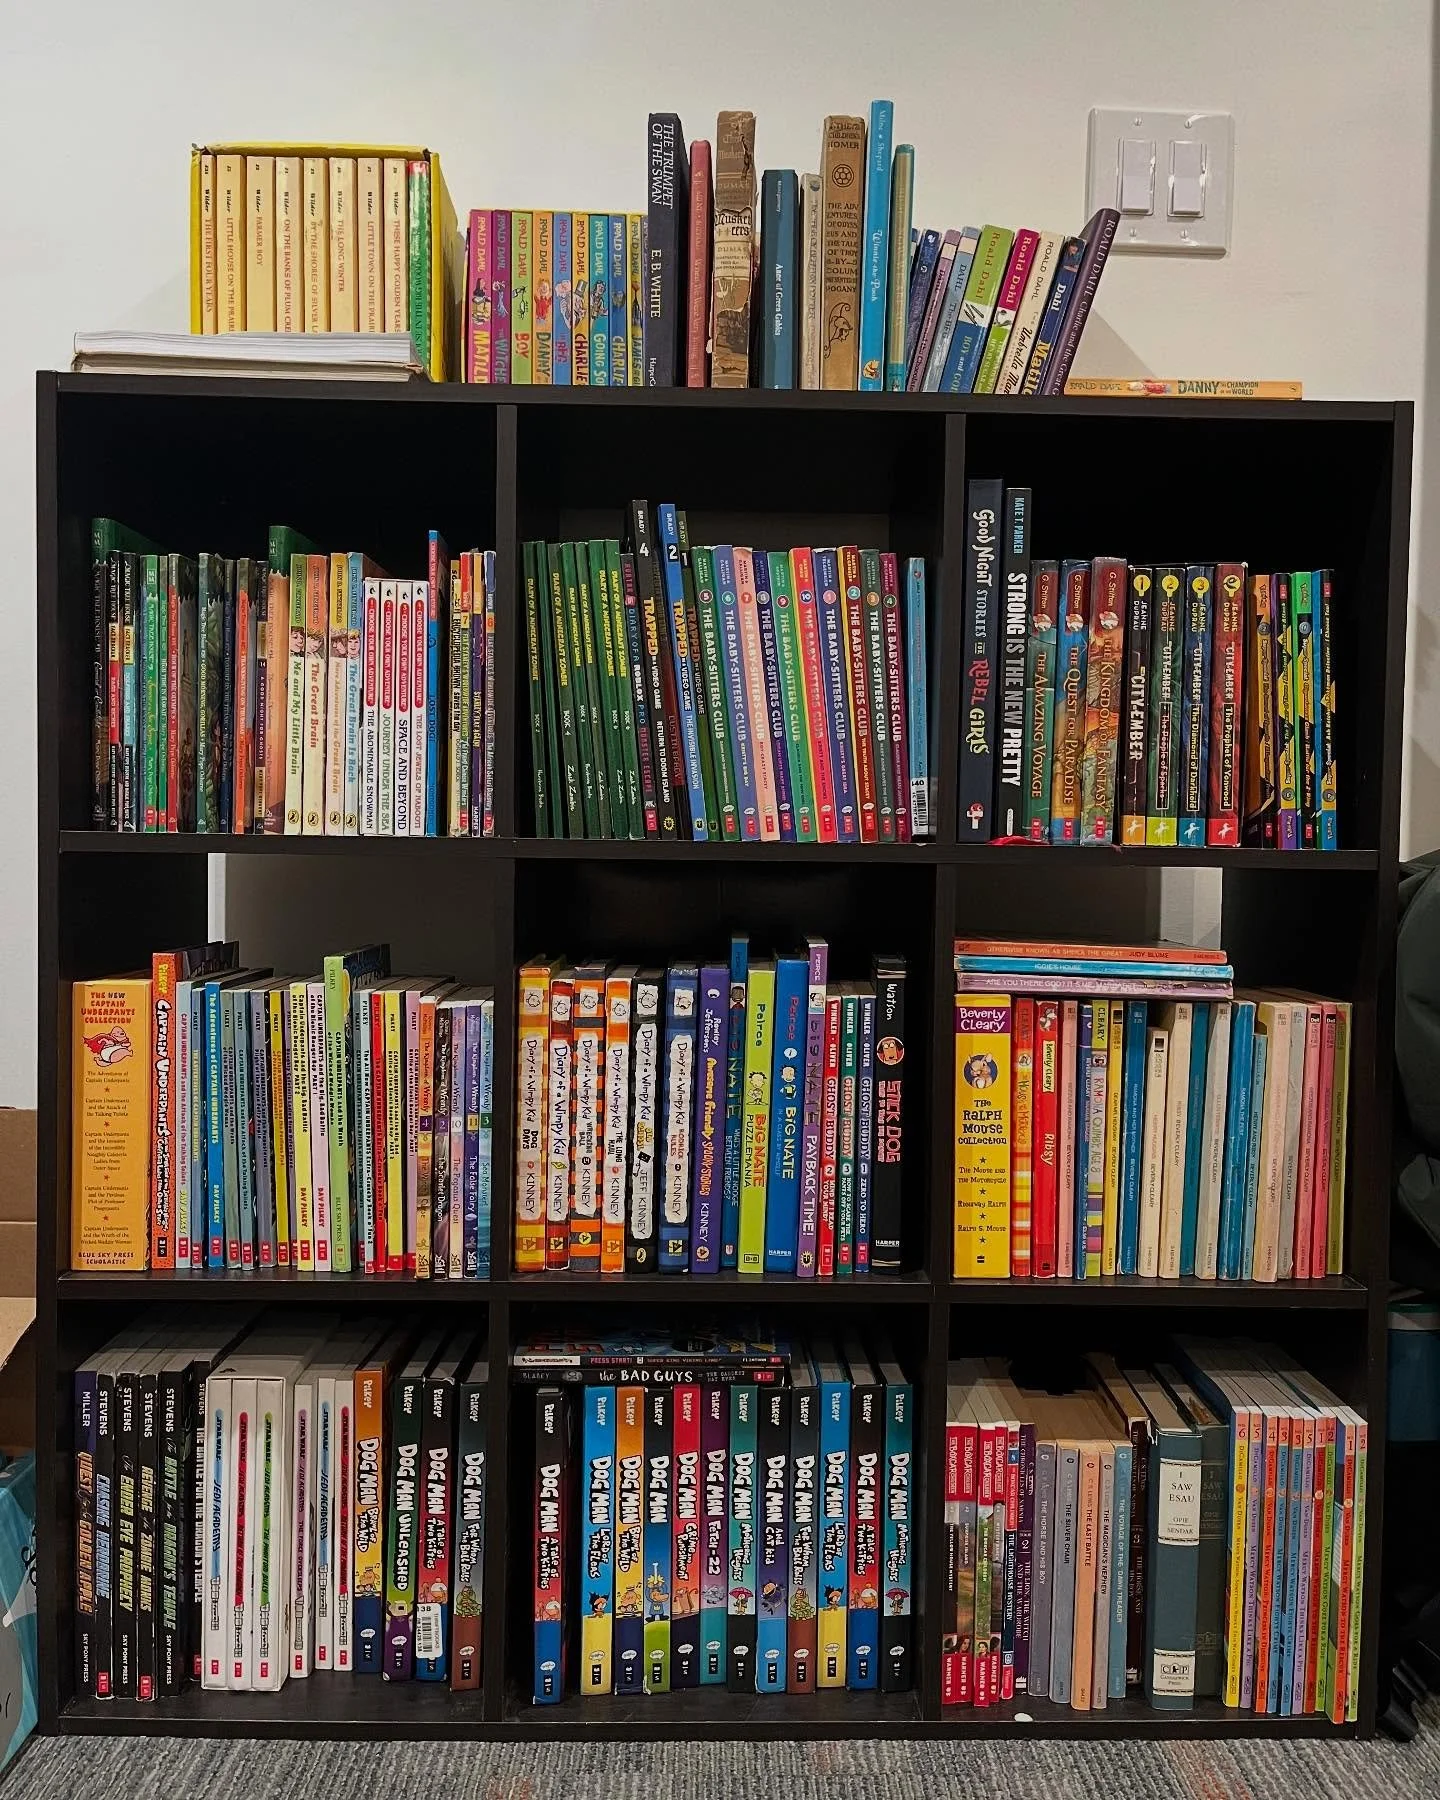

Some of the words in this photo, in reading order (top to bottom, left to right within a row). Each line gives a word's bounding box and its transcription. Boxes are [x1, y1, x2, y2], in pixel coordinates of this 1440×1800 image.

[652, 124, 662, 139] OF
[664, 124, 674, 147] THE
[652, 140, 662, 165] THE
[652, 168, 662, 204] SWAN
[663, 151, 674, 208] TRUMPET
[518, 219, 527, 248] ROALD
[1096, 220, 1116, 260] ROALD
[518, 253, 526, 278] DAHL
[651, 250, 661, 260] E.
[651, 263, 661, 272] B.
[1016, 236, 1032, 272] Roald
[775, 264, 783, 280] Anne
[1084, 264, 1102, 296] DAHL
[650, 277, 661, 318] WHITE
[775, 292, 783, 310] Green
[1006, 274, 1020, 304] Dahl
[1051, 283, 1066, 311] Dahl
[775, 314, 783, 336] Gables
[515, 333, 530, 358] BOY
[536, 332, 551, 376] DANNY
[575, 334, 588, 382] CHARLIE
[612, 336, 625, 384] CHARLIE
[1011, 328, 1032, 370] Umbrella
[1178, 381, 1219, 394] DANNY
[1015, 498, 1024, 516] KATE
[666, 513, 674, 536] BRADY
[1013, 526, 1024, 554] PARKER
[639, 543, 649, 557] 4
[669, 544, 678, 560] 2
[975, 590, 988, 638] STORIES
[1006, 573, 1027, 634] STRONG
[643, 597, 658, 655] TRAPPED
[673, 600, 688, 656] TRAPPED
[886, 612, 896, 633] THE
[400, 642, 408, 658] YOUR
[975, 642, 984, 654] FOR
[1006, 639, 1025, 654] IS
[1037, 653, 1046, 672] THE
[1069, 646, 1078, 666] THE
[292, 662, 301, 676] Me
[311, 664, 319, 680] The
[634, 664, 644, 701] ROBLOX
[652, 666, 660, 685] VIDEO
[888, 636, 900, 712] BABY-SITTERS
[969, 659, 990, 706] REBEL
[1005, 658, 1024, 686] THE
[292, 679, 300, 694] and
[310, 683, 319, 714] Great
[400, 672, 408, 708] ADVENTURE
[653, 688, 662, 709] GAME
[1064, 668, 1080, 715] QUEST
[1098, 662, 1112, 730] KINGDOM
[1131, 676, 1145, 706] CITY
[289, 697, 300, 714] My
[1004, 690, 1024, 724] NEW
[1034, 674, 1047, 742] AMAZING
[291, 718, 300, 744] Little
[310, 718, 318, 748] Brain
[398, 720, 408, 752] SPACE
[892, 714, 901, 742] CLUB
[1067, 718, 1076, 736] FOR
[1099, 734, 1108, 746] OF
[1130, 711, 1144, 760] EMBER
[290, 748, 300, 775] Brain
[366, 729, 374, 783] ABOMINABLE
[398, 758, 407, 780] AND
[1002, 728, 1022, 786] PRETTY
[1032, 744, 1044, 798] VOYAGE
[1064, 740, 1078, 804] PARADISE
[1096, 748, 1109, 808] FANTASY
[366, 786, 374, 830] SNOWMAN
[398, 785, 407, 830] BEYOND
[886, 984, 898, 1020] Watson
[960, 1008, 1006, 1020] Beverly
[1097, 1007, 1106, 1040] CLEARY
[554, 1046, 567, 1078] Diary
[555, 1081, 565, 1090] of
[825, 1077, 836, 1116] GHOST
[885, 1080, 901, 1120] STICK
[1093, 1078, 1104, 1114] RAMONA
[551, 1100, 565, 1134] Wimpy
[554, 1138, 566, 1154] Kid
[744, 1114, 754, 1188] PUZZLEMANIA
[825, 1119, 836, 1159] BUDDY
[885, 1126, 901, 1162] DOG
[754, 1145, 765, 1187] NATE
[805, 1135, 818, 1195] PAYBACK
[554, 1175, 563, 1213] KINNEY
[700, 1202, 710, 1241] KINNEY
[802, 1198, 816, 1236] TIME!
[621, 1370, 650, 1380] BAD
[654, 1370, 692, 1381] GUYS
[82, 1392, 90, 1426] MILLER
[122, 1388, 132, 1431] STEVENS
[78, 1453, 92, 1492] QUEST
[397, 1444, 418, 1477] DOG
[591, 1456, 612, 1491] DOG
[705, 1450, 725, 1485] DOG
[120, 1475, 134, 1514] ENDER
[396, 1479, 415, 1510] MAN
[590, 1493, 610, 1524] MAN
[706, 1486, 724, 1516] MAN
[1168, 1494, 1194, 1503] ESAU
[78, 1520, 92, 1569] GOLDEN
[120, 1520, 134, 1542] EYE
[164, 1524, 176, 1580] DRAGON'S
[1084, 1542, 1092, 1566] BATTLE
[77, 1572, 92, 1614] APPLE
[120, 1548, 133, 1611] PROPHECY
[163, 1584, 176, 1629] TEMPLE
